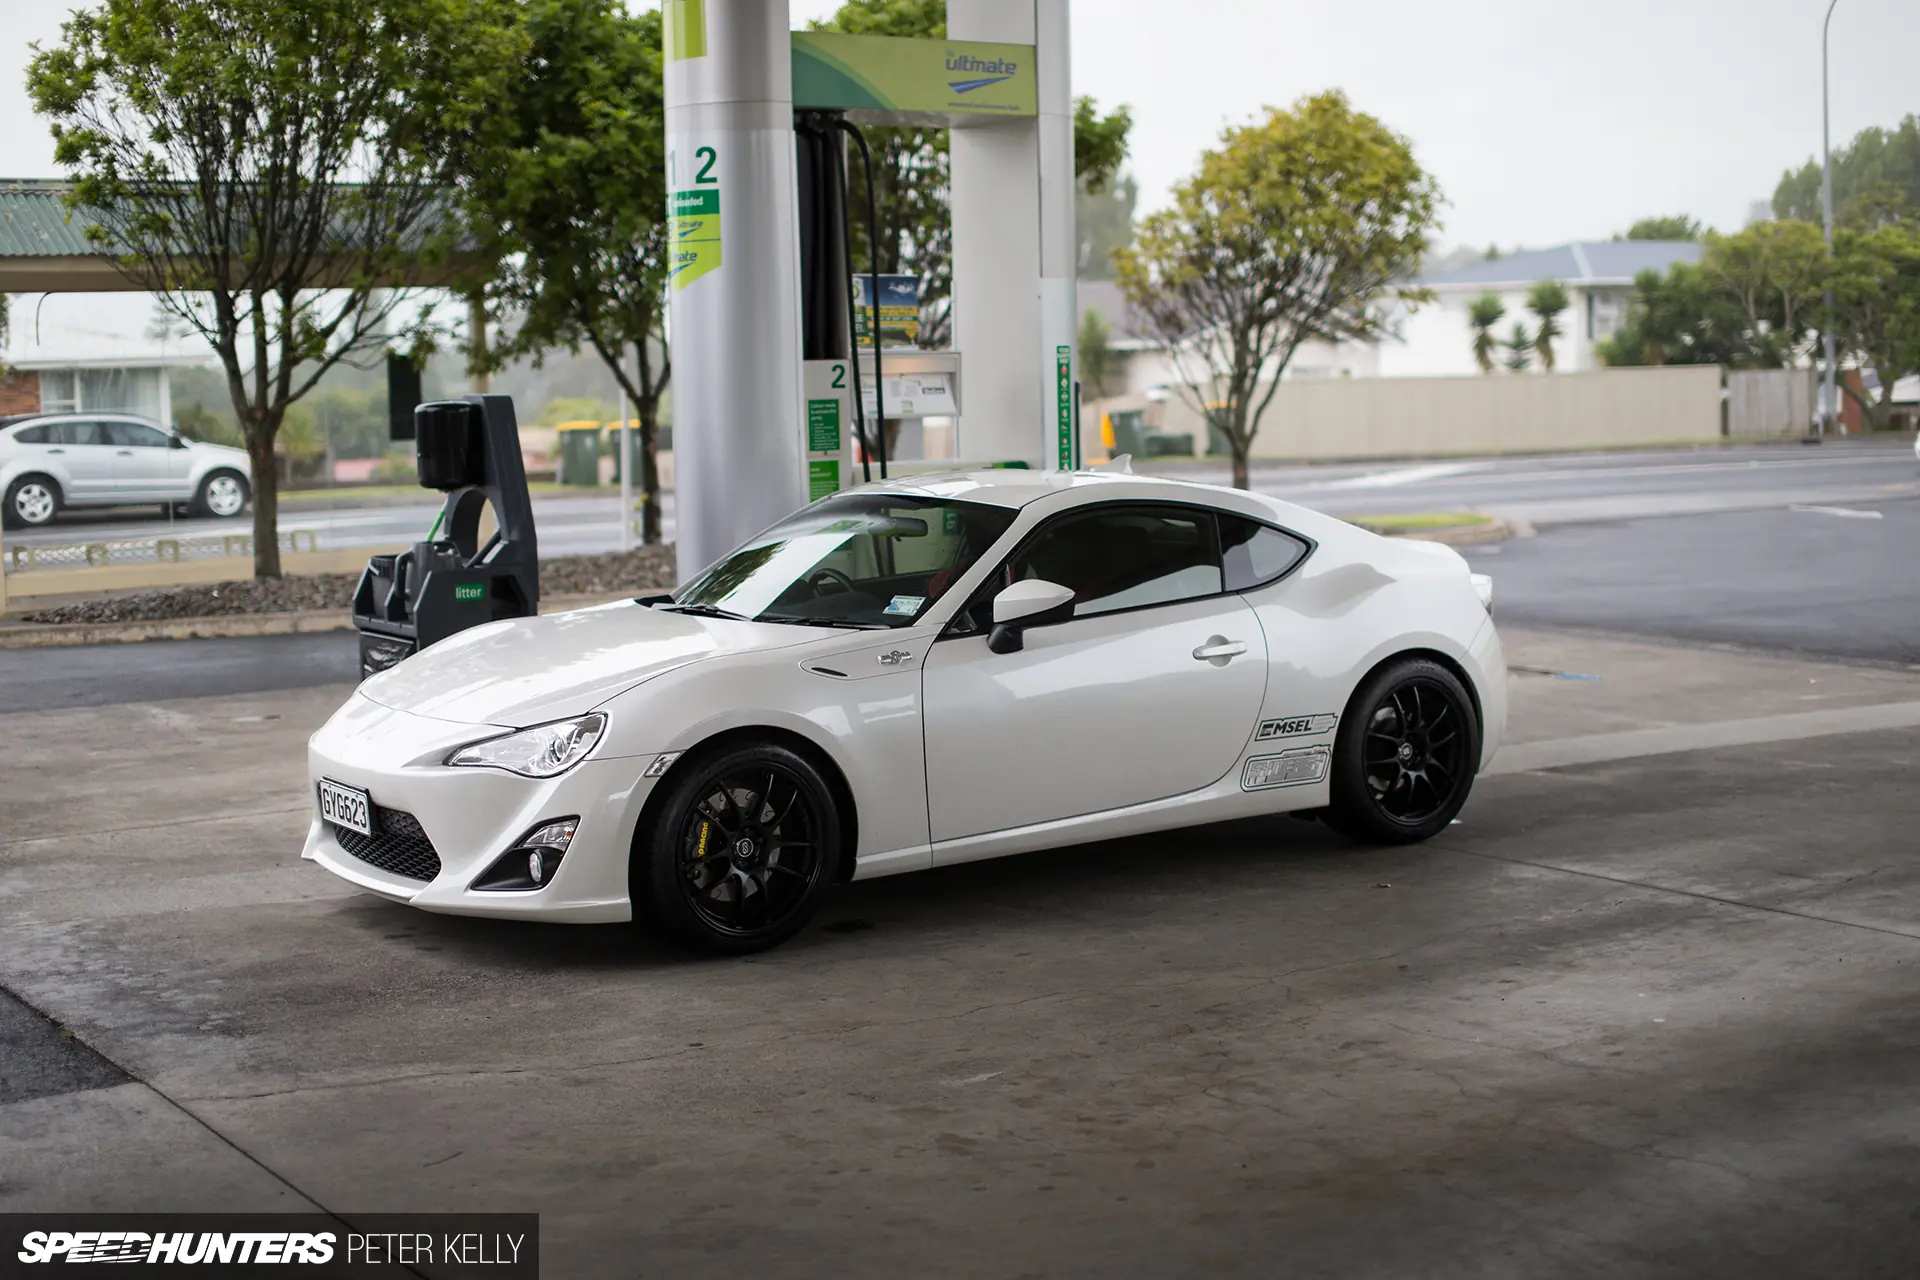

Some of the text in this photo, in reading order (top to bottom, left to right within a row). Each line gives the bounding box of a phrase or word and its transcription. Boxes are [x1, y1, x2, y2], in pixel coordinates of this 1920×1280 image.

[695, 146, 718, 184] 2
[831, 364, 846, 389] 2
[455, 587, 482, 599] litter
[322, 788, 367, 828] GYG623
